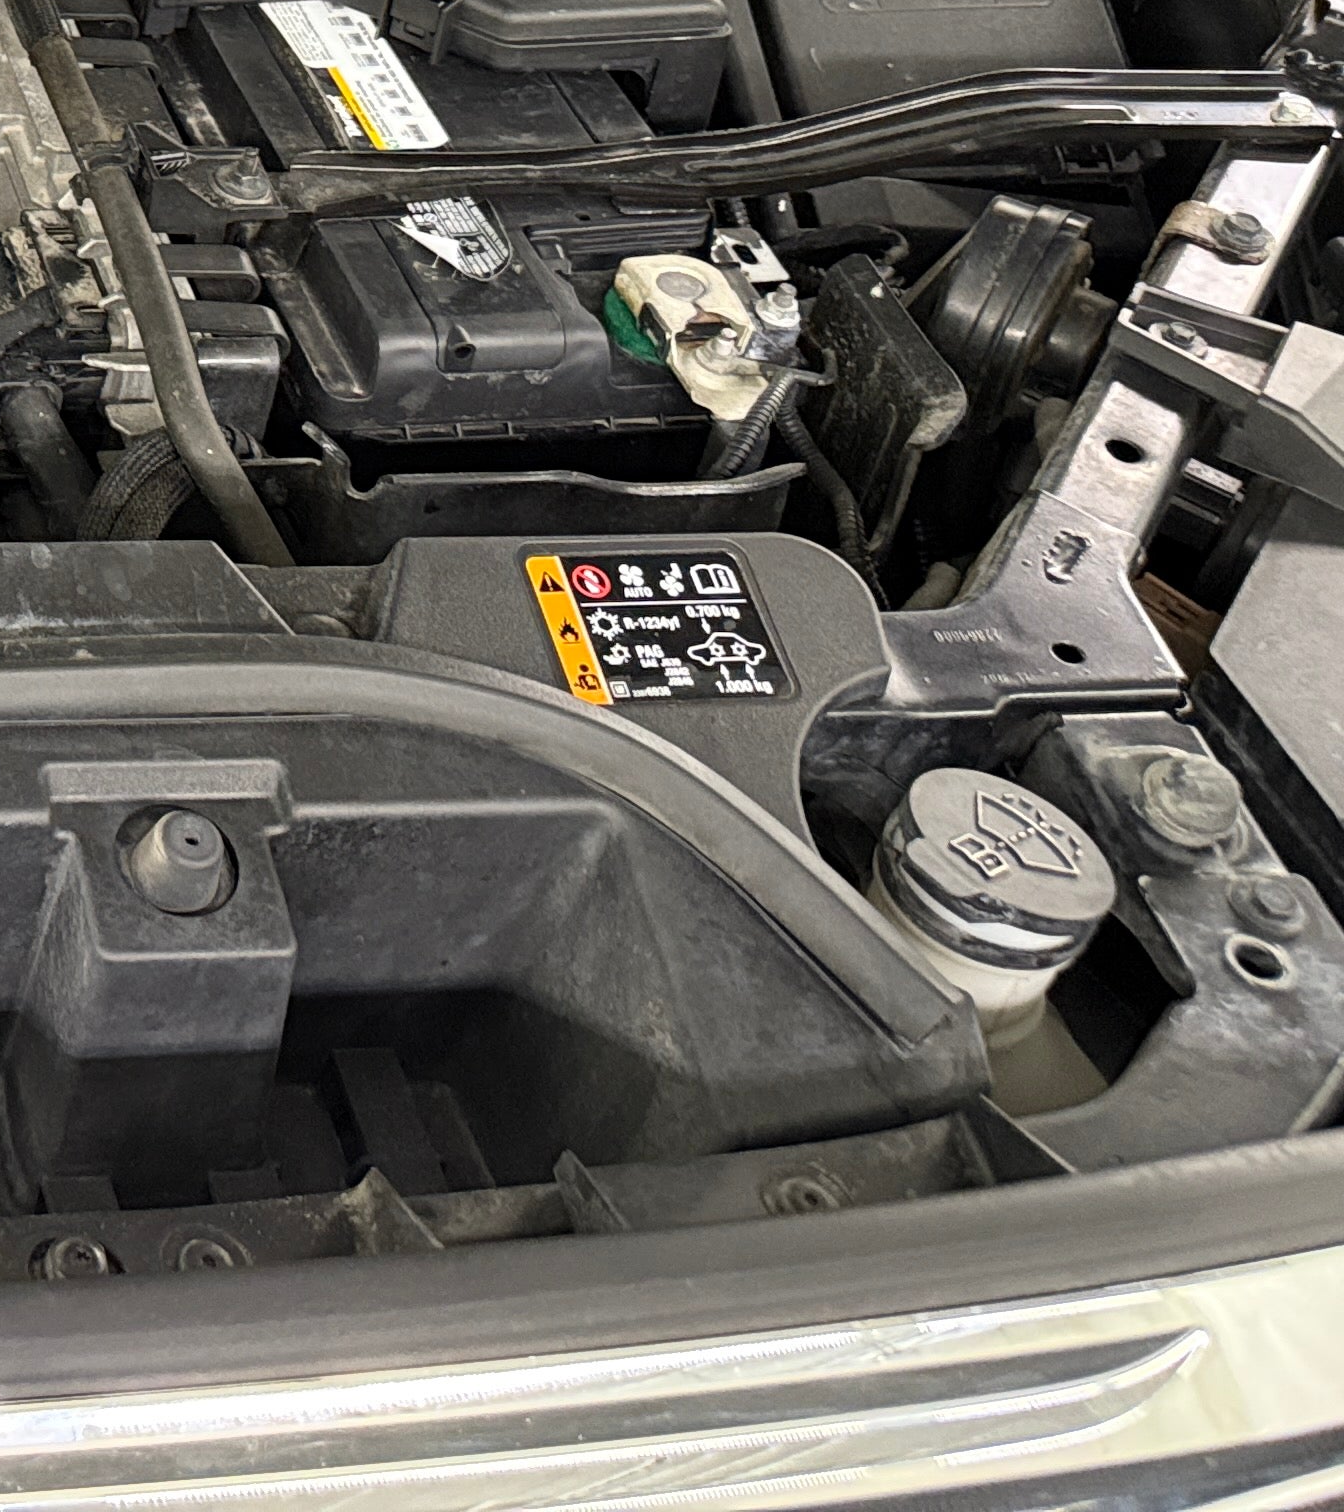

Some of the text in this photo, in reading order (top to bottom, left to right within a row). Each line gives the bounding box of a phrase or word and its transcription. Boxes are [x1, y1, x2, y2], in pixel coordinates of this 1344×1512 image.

[624, 586, 654, 599] AUTO
[685, 605, 741, 620] 0.700 kg
[623, 616, 681, 631] R-1234yf
[634, 644, 665, 659] PAG
[715, 679, 774, 695] 1.000 kg
